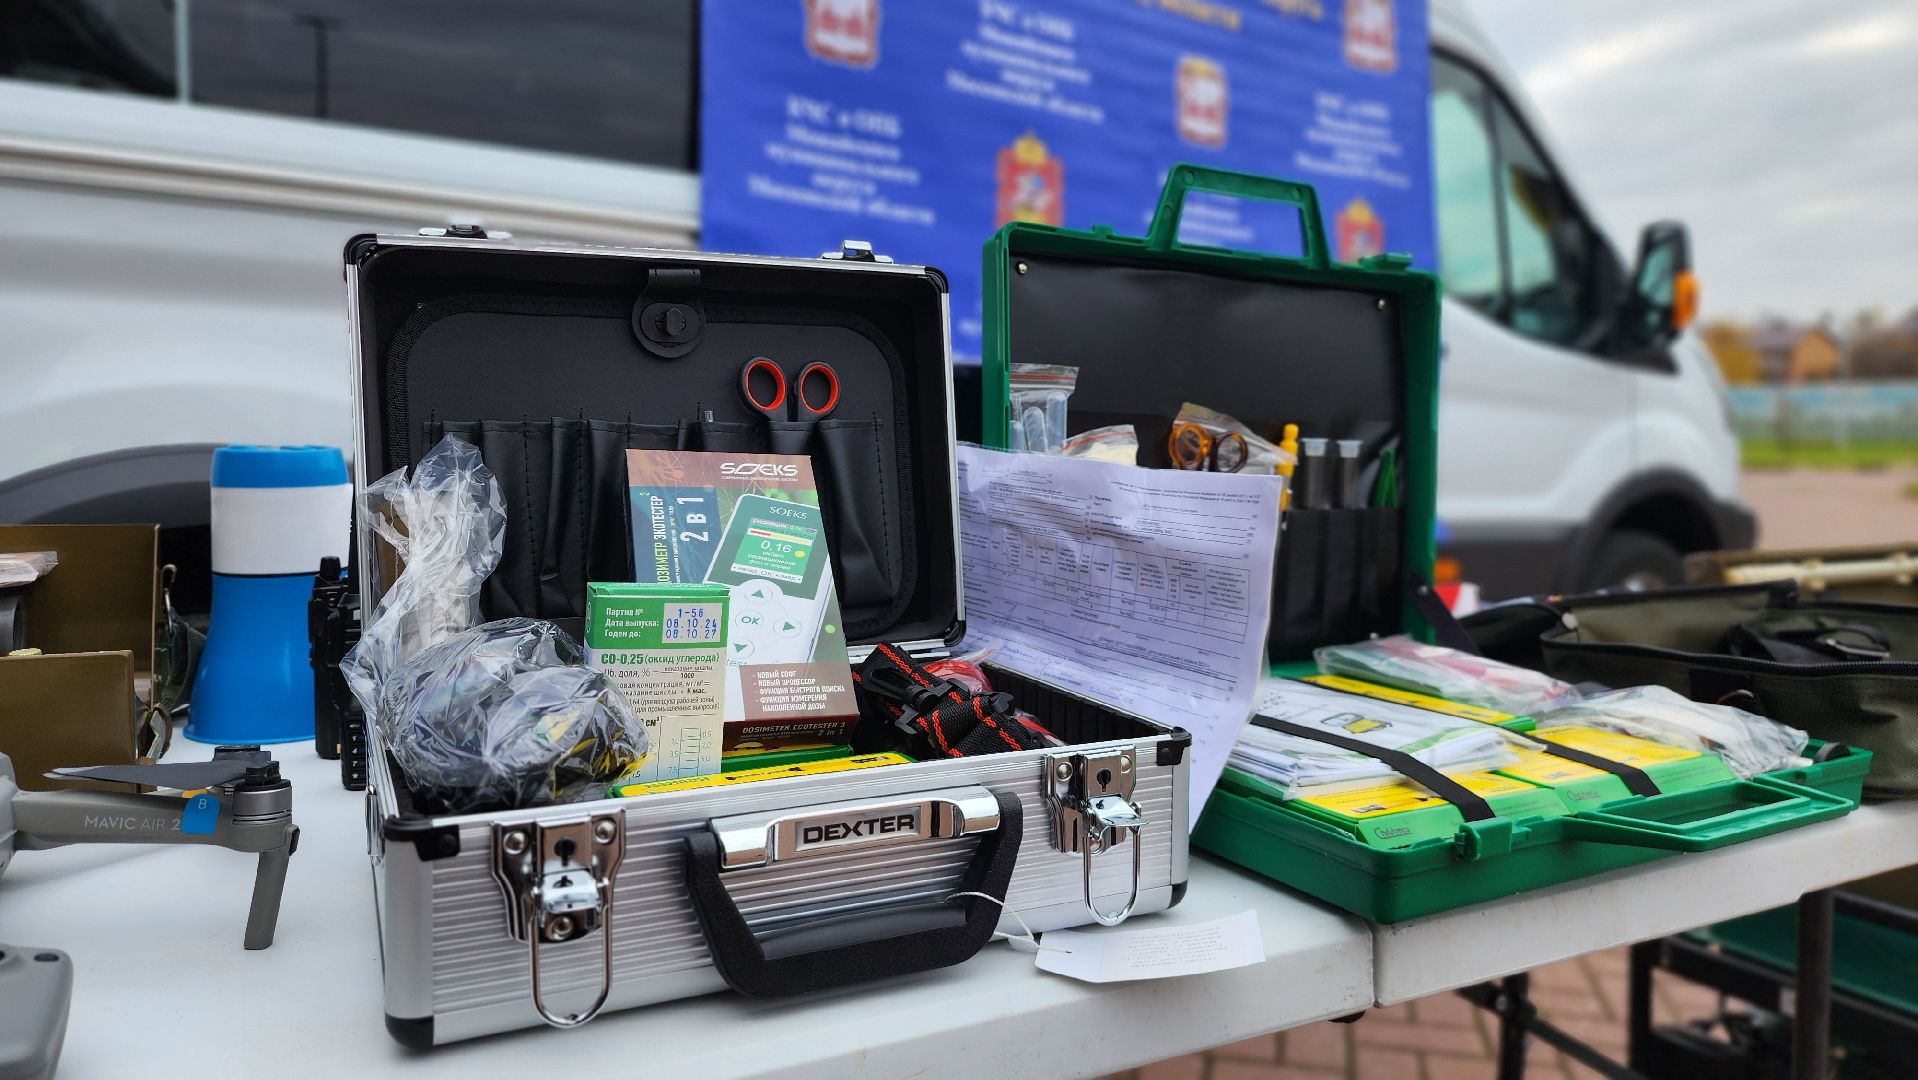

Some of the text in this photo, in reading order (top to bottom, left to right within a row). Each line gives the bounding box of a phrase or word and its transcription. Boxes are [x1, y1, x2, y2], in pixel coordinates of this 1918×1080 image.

[720, 463, 799, 477] SOEKS
[677, 497, 704, 505] 1
[651, 495, 666, 540] ЭКОТЕСТЕР
[770, 506, 807, 519] SOEKS
[680, 531, 709, 542] 2
[606, 607, 704, 618] Партия № 1-56
[605, 618, 717, 629] Дата выпуска: 08.10.24
[741, 615, 760, 625] OK
[605, 629, 717, 639] Годен до: 08.10.27
[645, 653, 674, 665] (оксид
[676, 652, 720, 664] углерода)
[618, 669, 640, 679] доля,
[757, 670, 797, 679] НОВЫЙ СОФТ
[758, 678, 816, 687] НОВЫЙ ПРОЦЕССОР
[759, 685, 846, 696] ФУНКЦИЯ БЫСТРОГО ПОИСКА
[760, 694, 828, 704] ФУНКЦИЯ ИЗМЕРЕНИЯ
[762, 702, 826, 712] НАКОПЛЕННОЙ ДОЗЫ
[742, 725, 790, 734] DOSIMETER
[792, 722, 838, 731] ECOTESTER
[198, 798, 207, 810] B
[84, 815, 181, 831] MAVIC AIR 2
[803, 814, 915, 844] DEXTER
